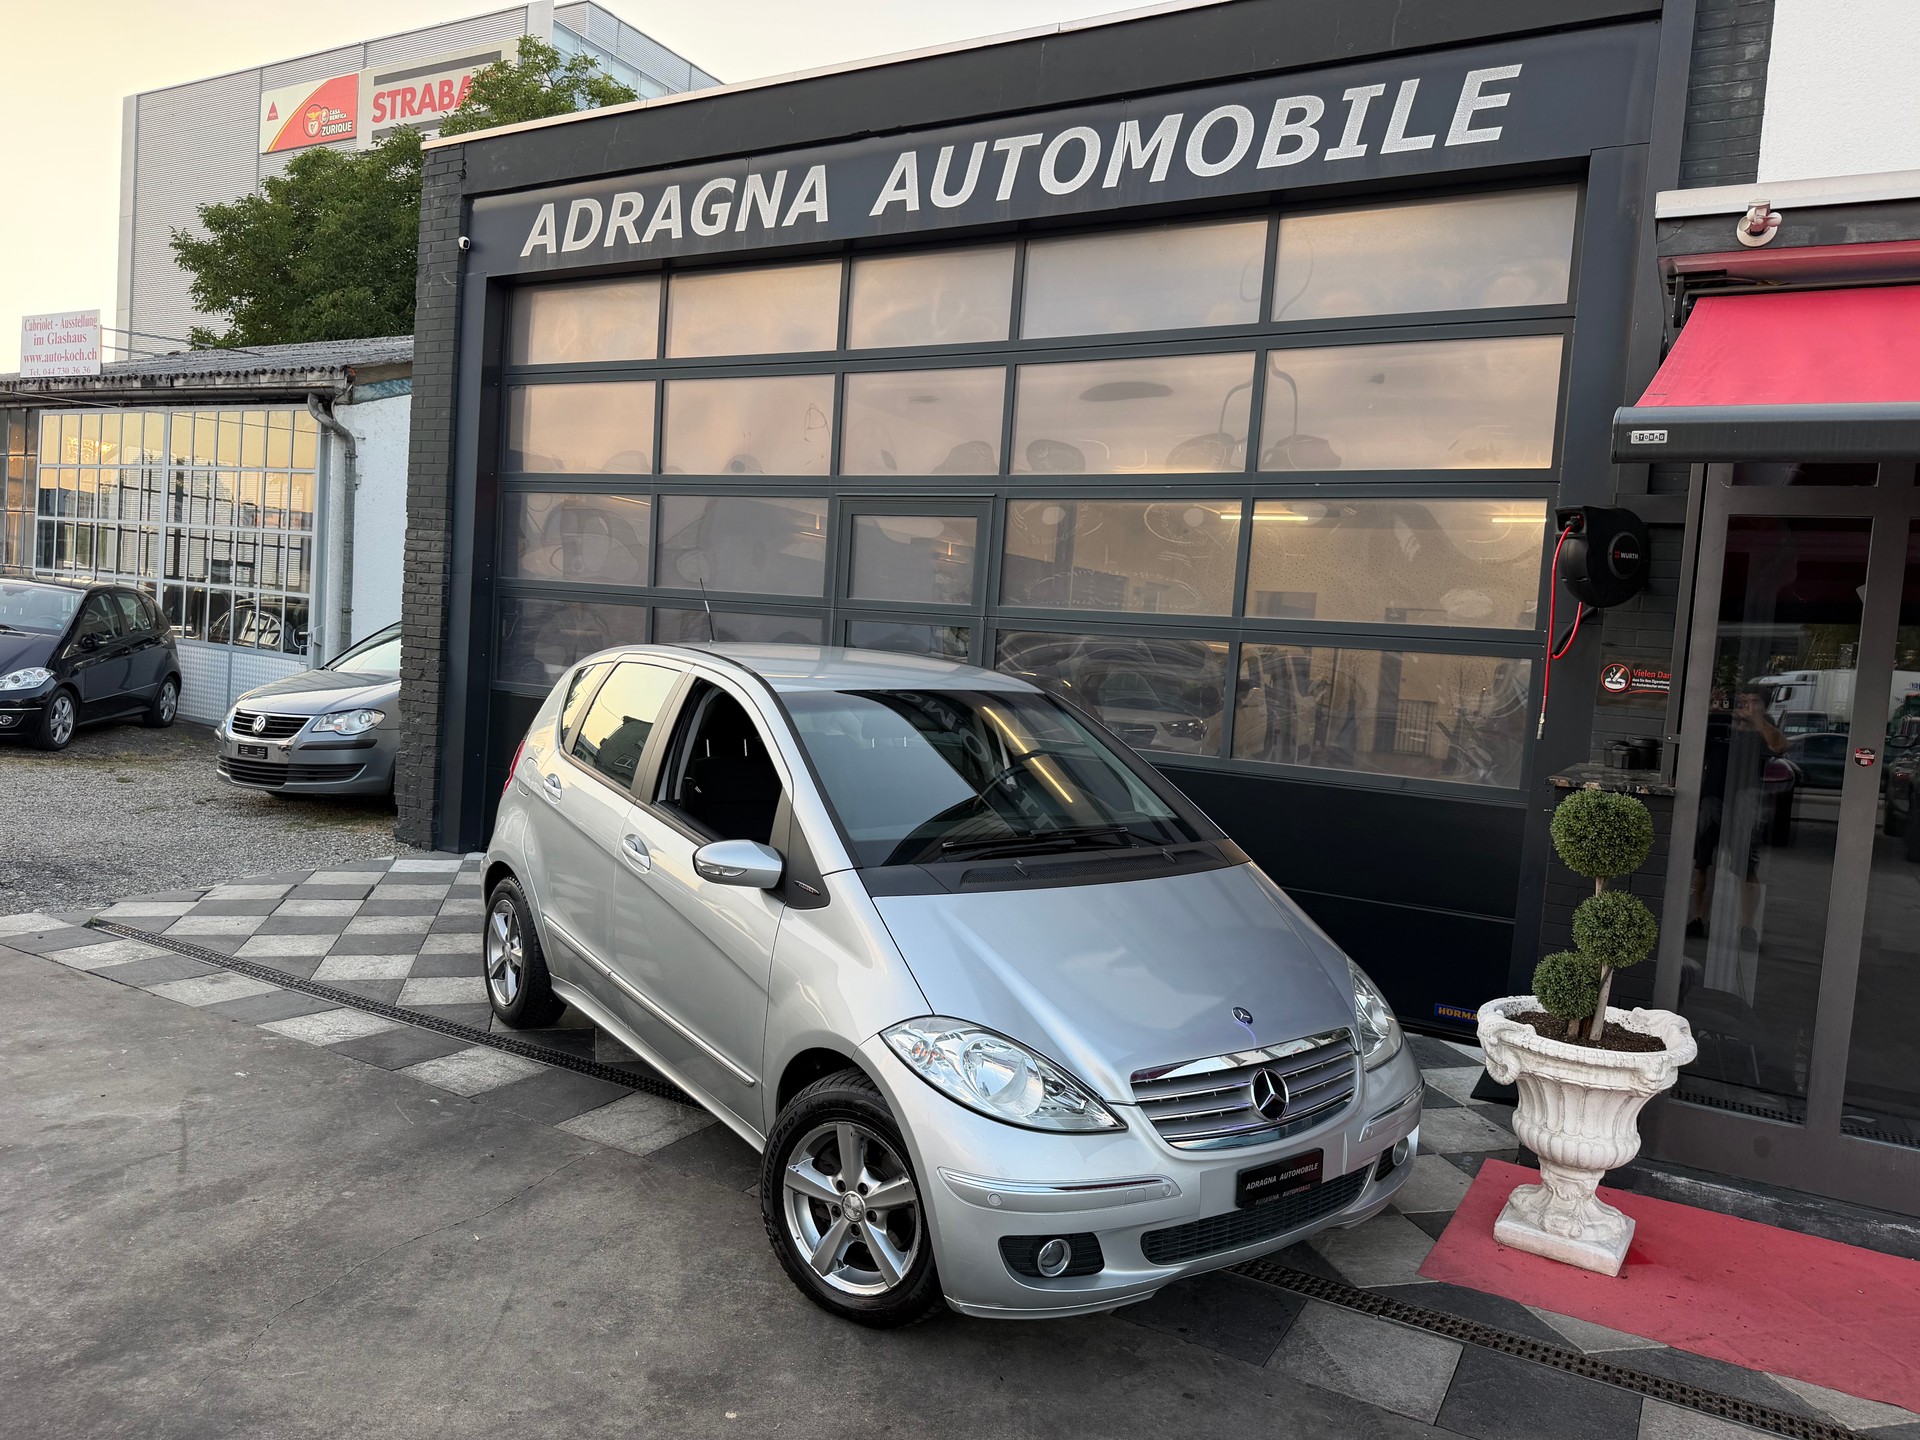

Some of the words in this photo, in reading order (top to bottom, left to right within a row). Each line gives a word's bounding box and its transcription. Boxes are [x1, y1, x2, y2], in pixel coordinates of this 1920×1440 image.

[372, 74, 480, 123] STRABA
[321, 121, 353, 136] ZURIQUE
[519, 164, 829, 257] ADRAGNA
[869, 63, 1522, 217] AUTOMOBILE
[24, 318, 53, 332] Cabriolet
[60, 314, 98, 331] Ausstellung
[33, 333, 44, 346] im
[47, 331, 87, 346] Glashaus
[23, 347, 98, 364] www.auto-koch.ch
[1633, 669, 1656, 678] Vielen
[1657, 671, 1672, 679] Dan
[1438, 1006, 1478, 1020] HORMA
[1245, 1175, 1277, 1191] ADRAGNA
[1279, 1162, 1319, 1181] AUTOMOBILE
